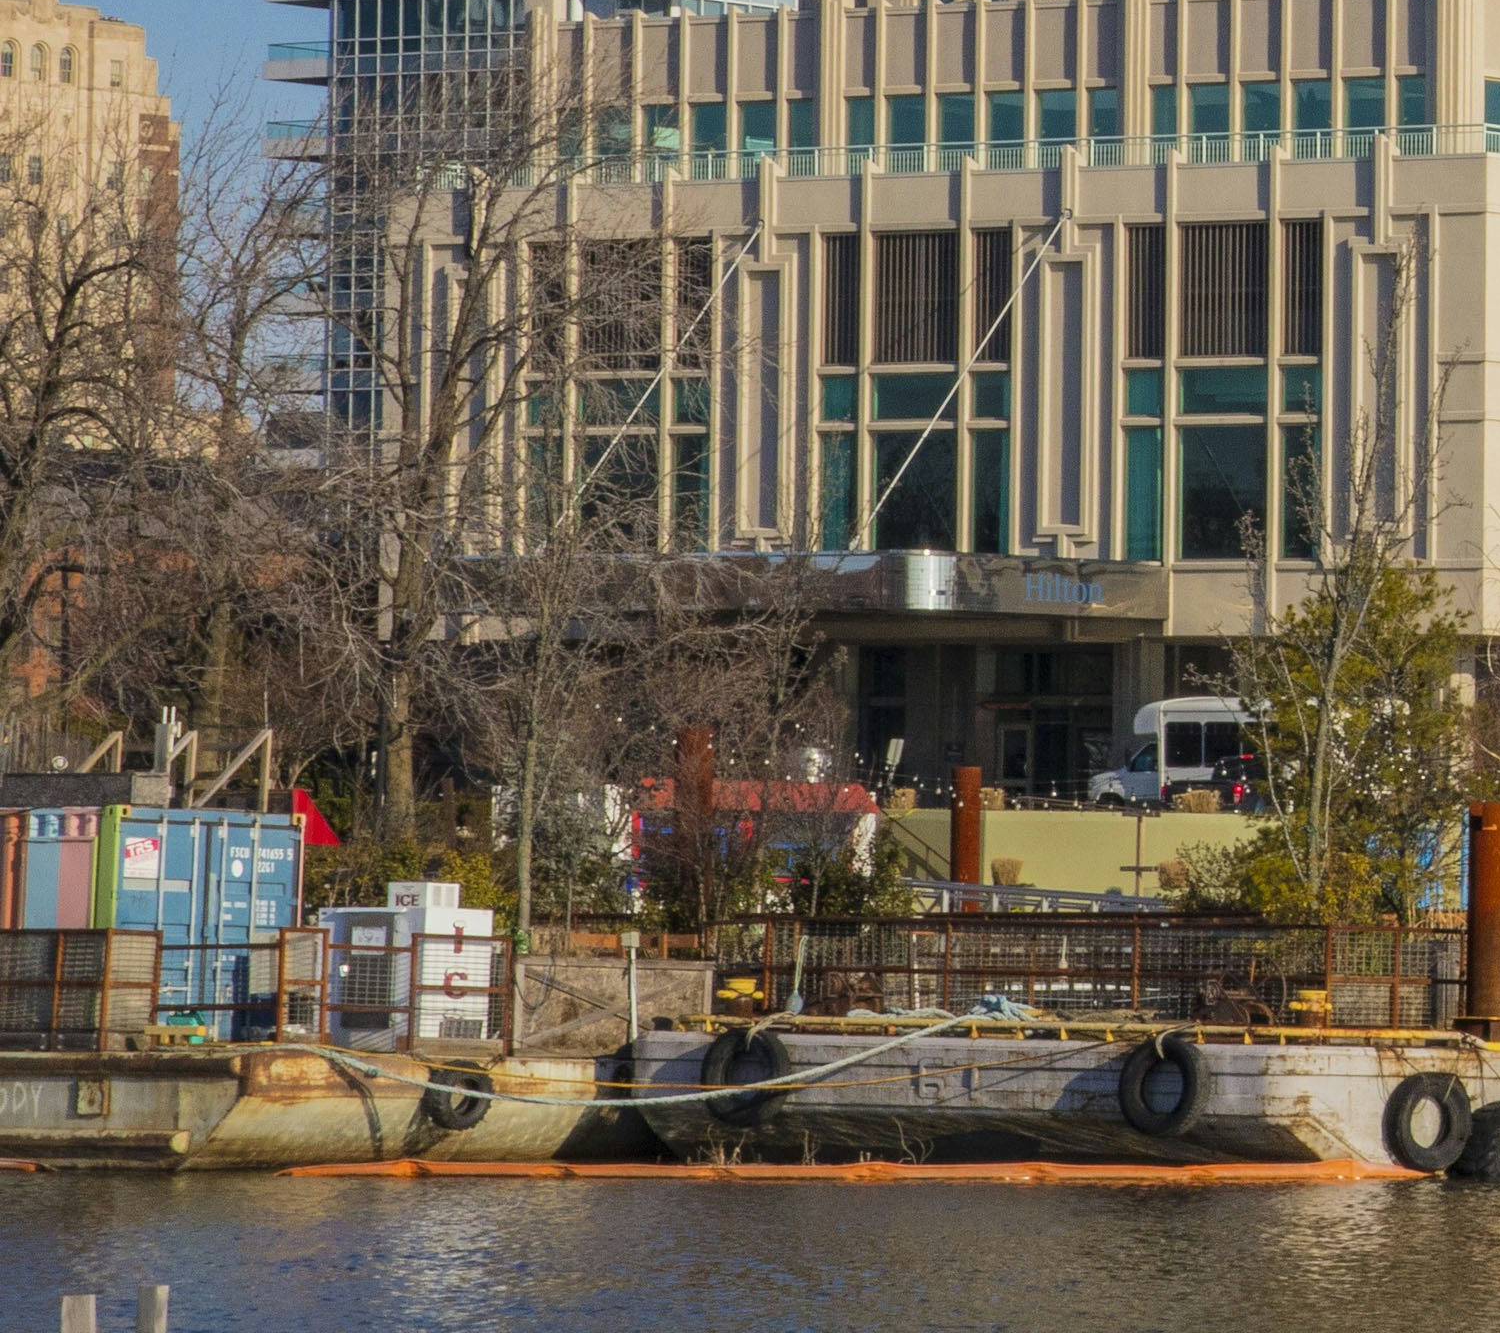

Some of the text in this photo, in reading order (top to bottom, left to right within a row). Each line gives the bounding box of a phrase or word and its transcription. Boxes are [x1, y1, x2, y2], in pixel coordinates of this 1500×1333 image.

[1025, 572, 1105, 604] Hilton
[127, 839, 154, 858] TRS
[395, 893, 420, 907] ICE
